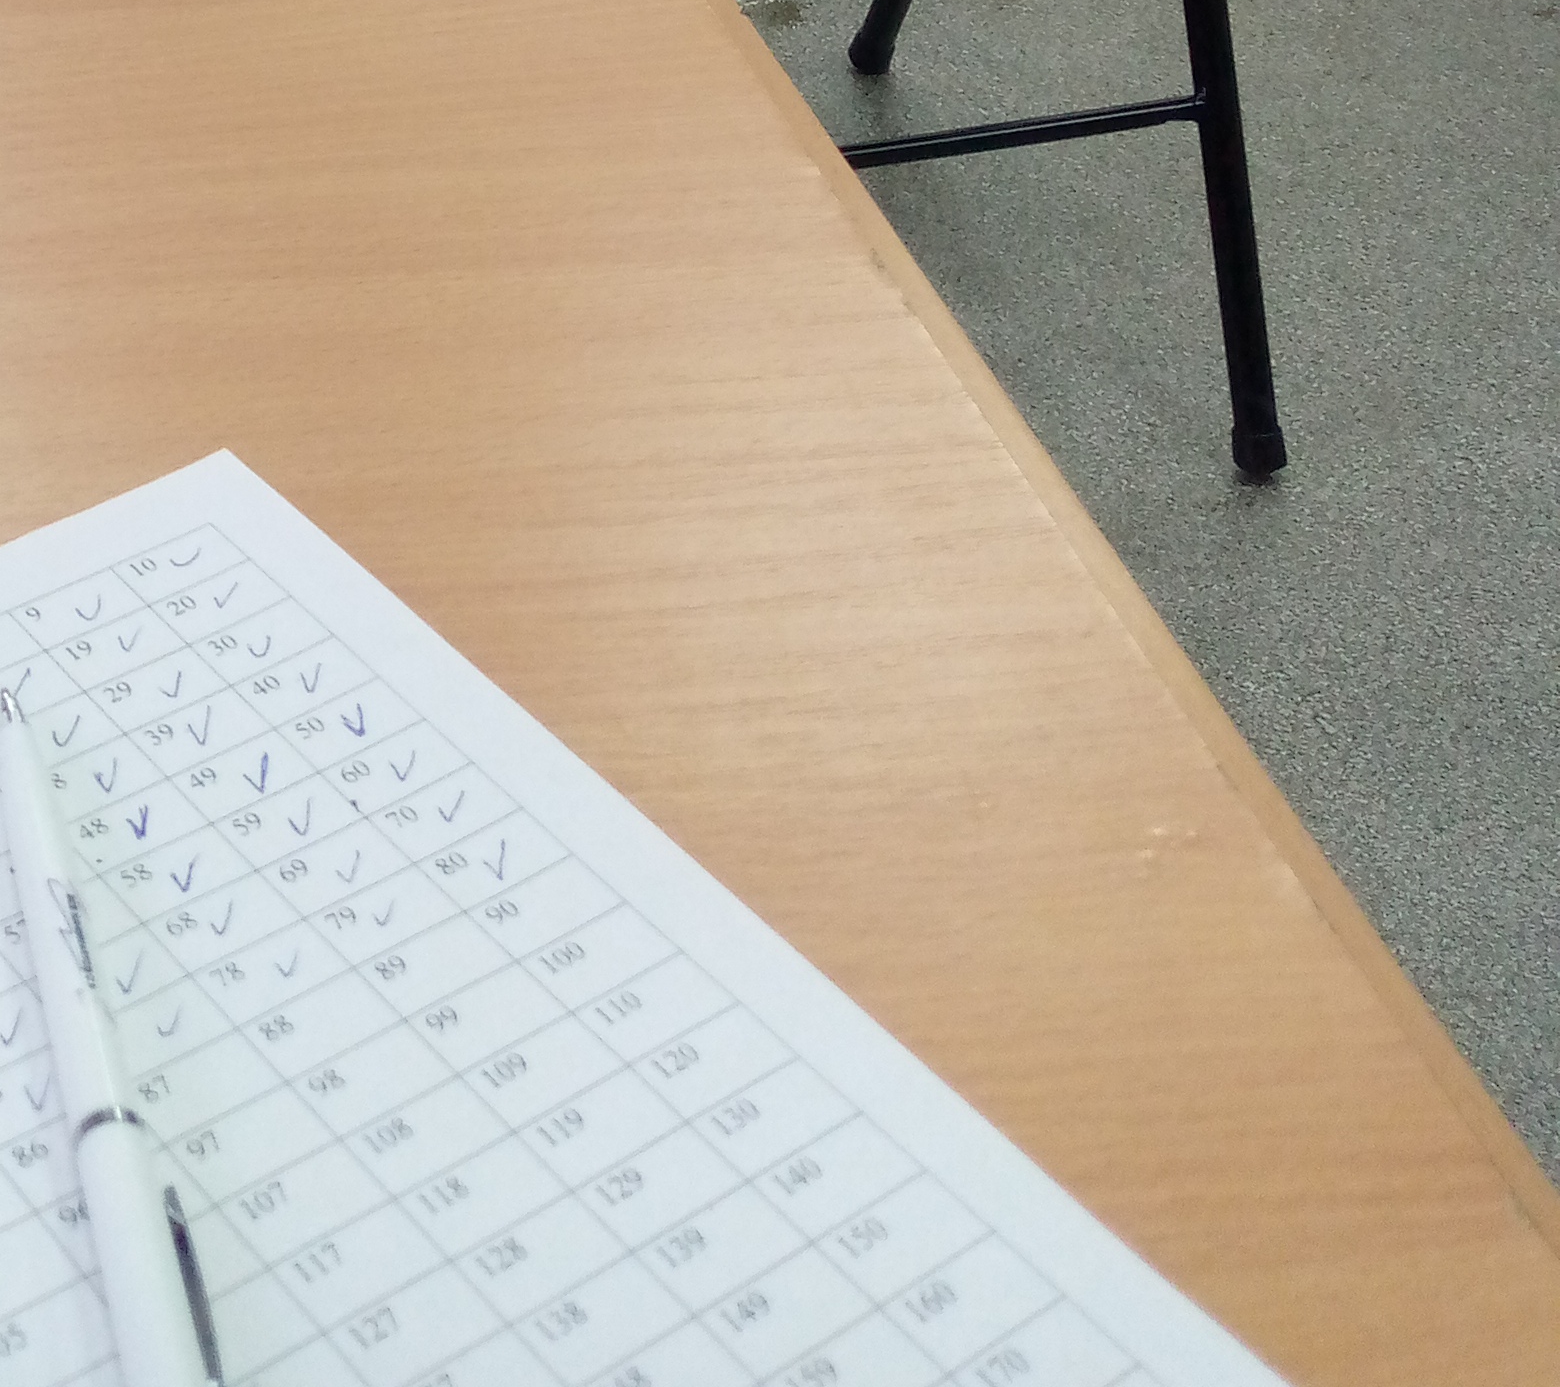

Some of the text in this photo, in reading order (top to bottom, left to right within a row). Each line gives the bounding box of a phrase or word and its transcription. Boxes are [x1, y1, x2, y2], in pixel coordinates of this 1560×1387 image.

[24, 606, 41, 620] 9
[128, 557, 157, 576] 10
[64, 639, 92, 660] 19
[165, 595, 196, 616] 20
[102, 681, 132, 703] 29
[207, 634, 237, 652] 30
[51, 773, 67, 789] 8
[143, 723, 174, 746] 39
[252, 674, 280, 694] 40
[79, 817, 109, 839] 48
[189, 766, 217, 787] 49
[294, 716, 325, 734] 50
[119, 862, 152, 882] 58
[231, 811, 261, 836] 59
[339, 760, 371, 783] 60
[165, 805, 418, 936] 68 69 70
[434, 852, 468, 875] 80
[484, 900, 519, 924] 90
[538, 941, 586, 974] 100
